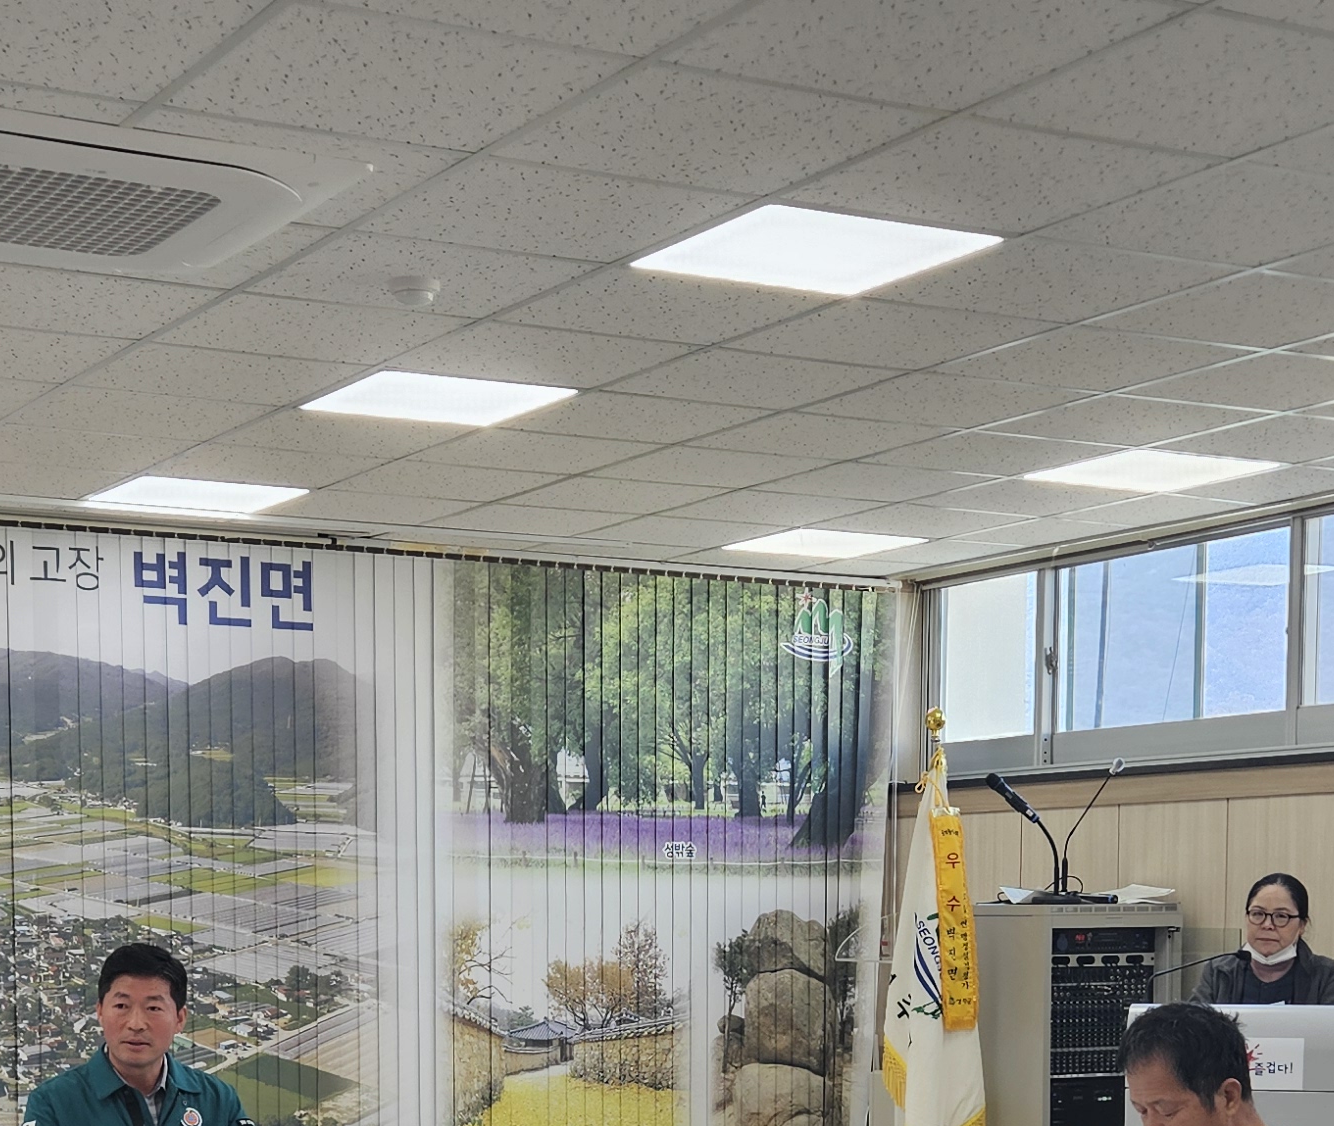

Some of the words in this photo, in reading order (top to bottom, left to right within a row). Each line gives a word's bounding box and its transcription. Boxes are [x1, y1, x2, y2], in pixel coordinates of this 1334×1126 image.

[30, 545, 104, 591] 고장
[134, 551, 315, 632] 벽진면
[793, 635, 830, 646] SEONGJU
[664, 842, 696, 858] 성밖숲
[1254, 1061, 1294, 1076] 즐겁다!
